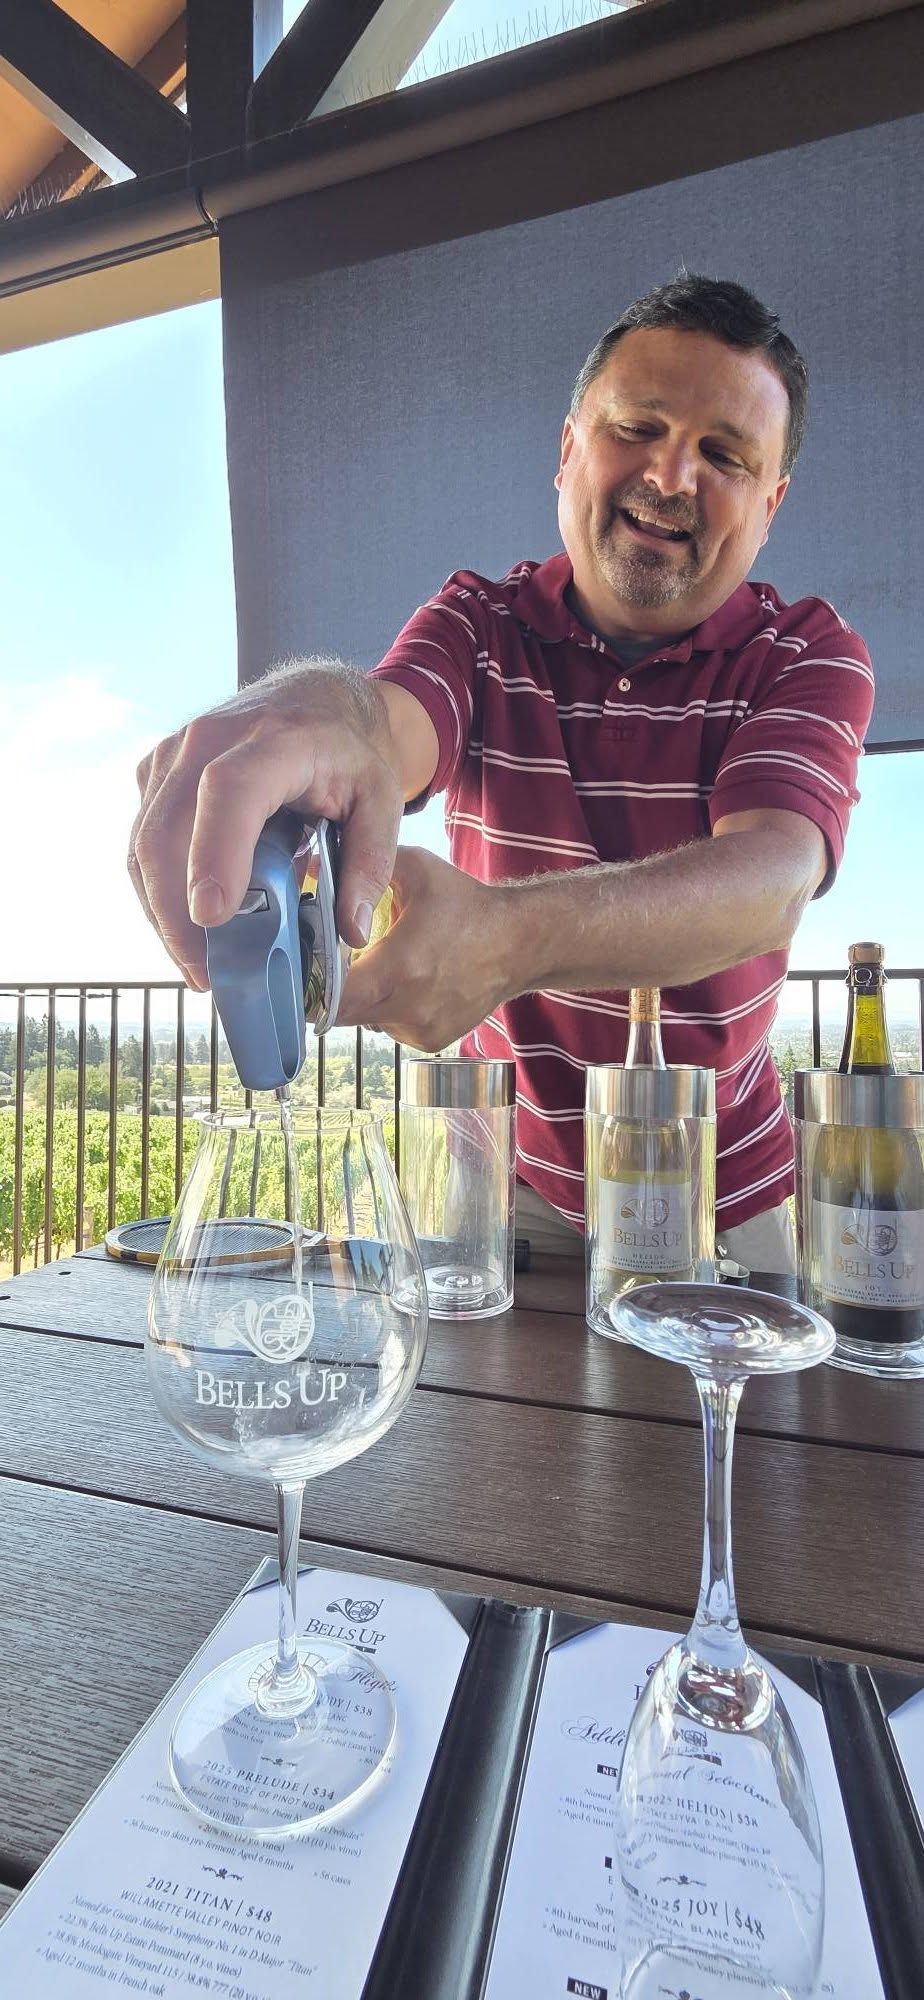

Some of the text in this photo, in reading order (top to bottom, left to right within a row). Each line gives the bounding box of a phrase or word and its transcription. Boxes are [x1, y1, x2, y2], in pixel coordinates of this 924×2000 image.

[613, 1228, 683, 1248] BELLS UP
[832, 1255, 914, 1280] BELLS UP
[195, 1368, 348, 1409] BELLS UP
[304, 1617, 386, 1646] BELLS UP
[353, 1704, 374, 1717] $38
[203, 1759, 232, 1776] 2025
[236, 1769, 301, 1792] PRELUDE
[311, 1786, 335, 1801] $34
[272, 1793, 300, 1806] PINOT
[583, 1786, 612, 1801] Named
[563, 1807, 584, 1821] Aged
[676, 1796, 726, 1820] HELIOS
[237, 1849, 260, 1864] Aged
[264, 1856, 295, 1872] months
[262, 1842, 286, 1854] vines)
[338, 1845, 362, 1857] vines)
[146, 1876, 180, 1897] 2021
[184, 1886, 233, 1913] TITAN
[246, 1905, 273, 1924] $48
[120, 1888, 282, 1947] WILLAMETTE VALLEY PINOT NOIR
[567, 1909, 599, 1931] harvest
[687, 1897, 719, 1918] JOY
[734, 1906, 766, 1941] $48
[175, 1926, 216, 1949] Symphony
[549, 1921, 574, 1939] Aged
[582, 1933, 617, 1952] months
[109, 1927, 124, 1943] Up
[147, 1939, 192, 1961] Pommard
[214, 1961, 243, 1978] vines)
[123, 1950, 163, 1977] Vineyard
[75, 1959, 107, 1978] months
[117, 1970, 148, 1991] French
[147, 1983, 166, 1997] oak
[573, 1979, 602, 2000] NEW
